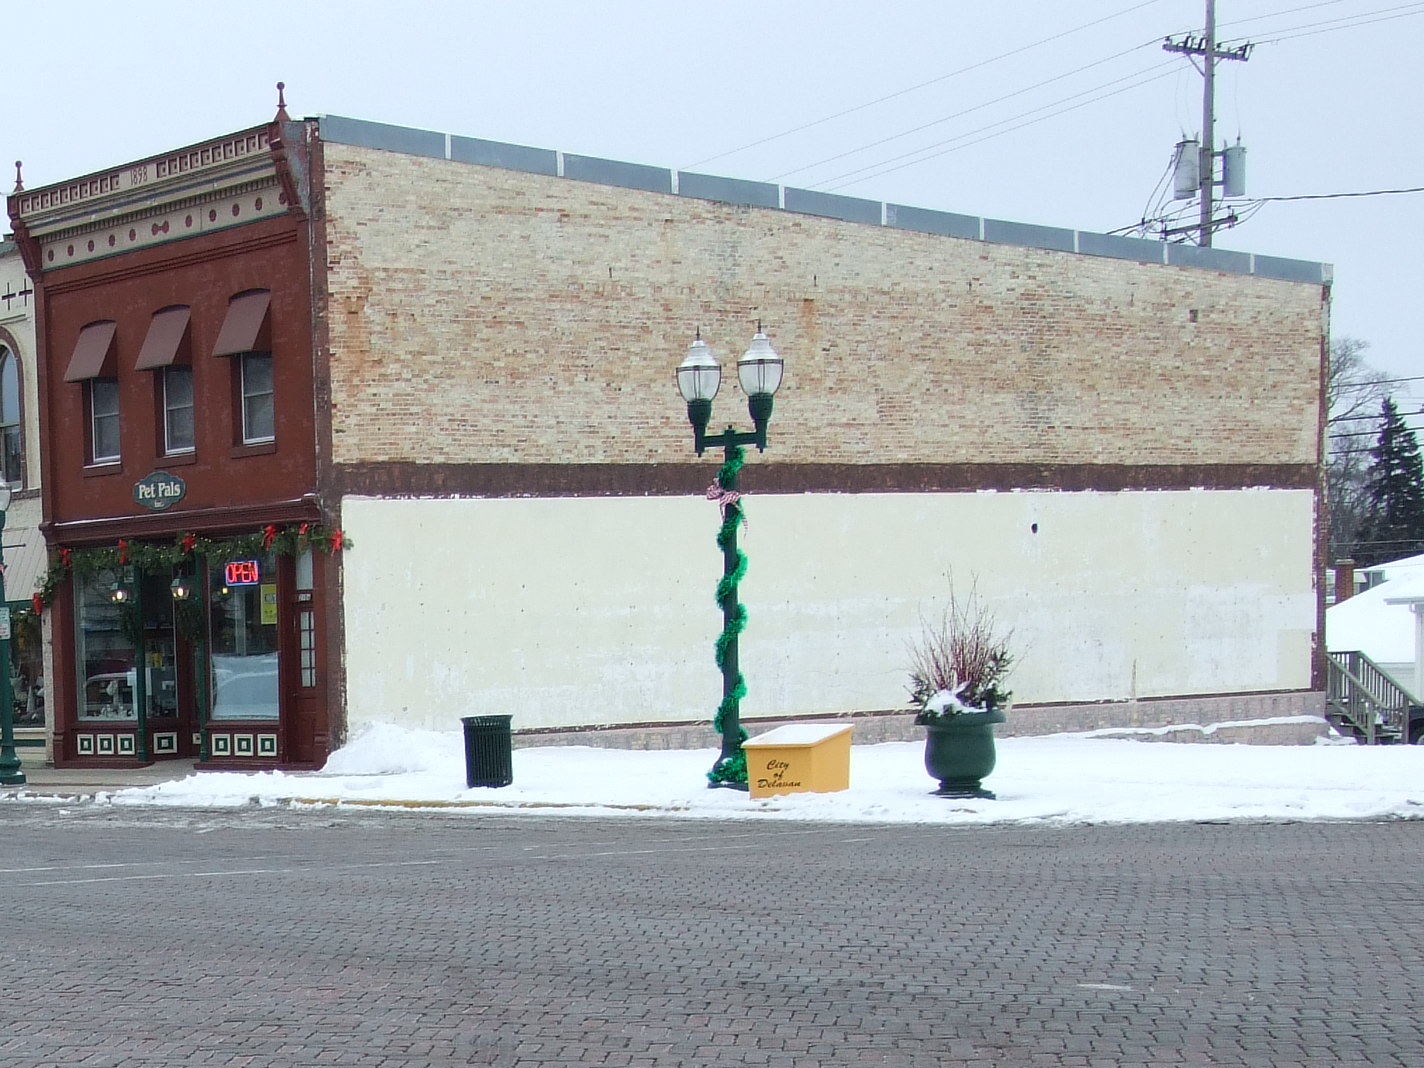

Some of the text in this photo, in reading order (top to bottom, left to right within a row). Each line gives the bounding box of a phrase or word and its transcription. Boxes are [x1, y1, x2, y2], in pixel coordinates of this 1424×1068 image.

[130, 166, 148, 186] 1898
[138, 481, 181, 500] Pet Pals
[226, 562, 257, 583] OPEN
[766, 759, 789, 770] City
[773, 770, 784, 781] of
[757, 778, 801, 789] Delavan
